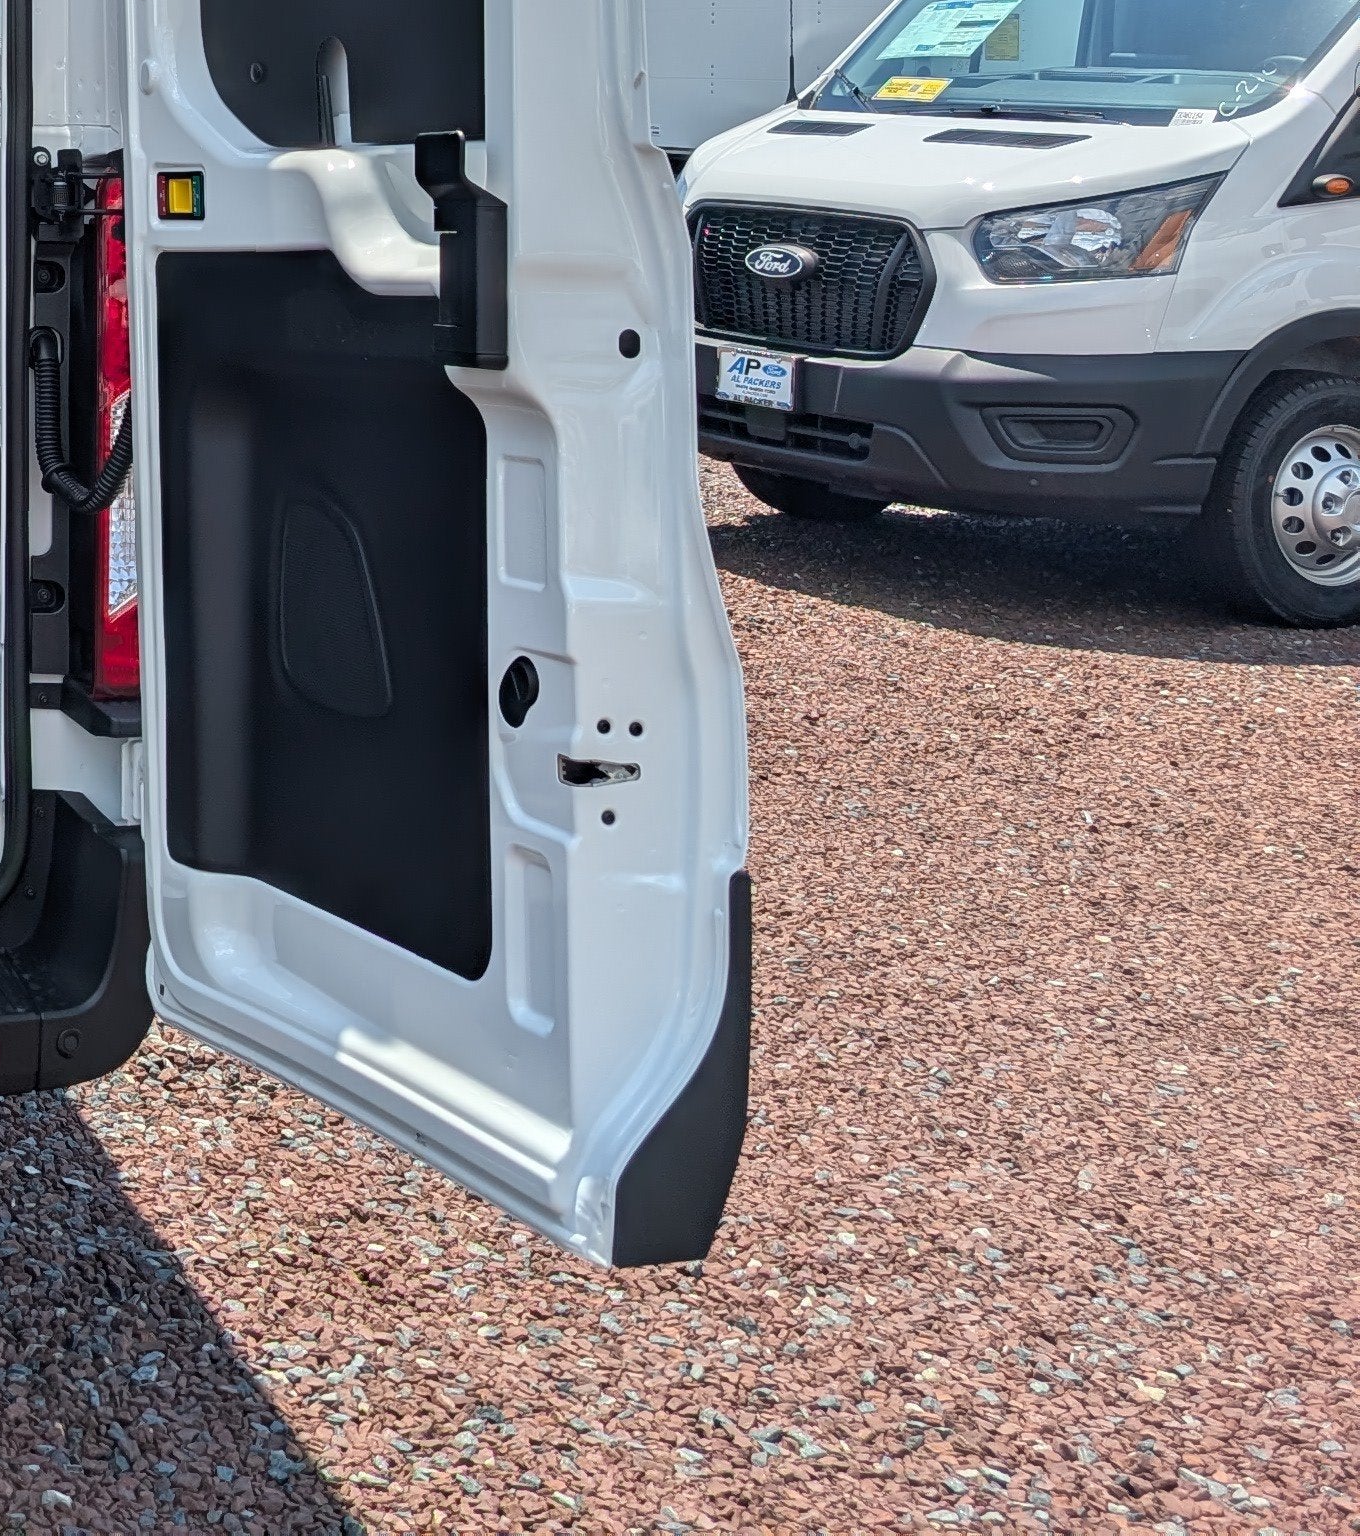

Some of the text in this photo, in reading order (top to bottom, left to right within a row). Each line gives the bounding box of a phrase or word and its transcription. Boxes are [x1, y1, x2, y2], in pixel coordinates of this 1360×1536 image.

[755, 251, 791, 273] Ford
[727, 356, 761, 375] AP
[731, 374, 782, 390] AL PACKERS
